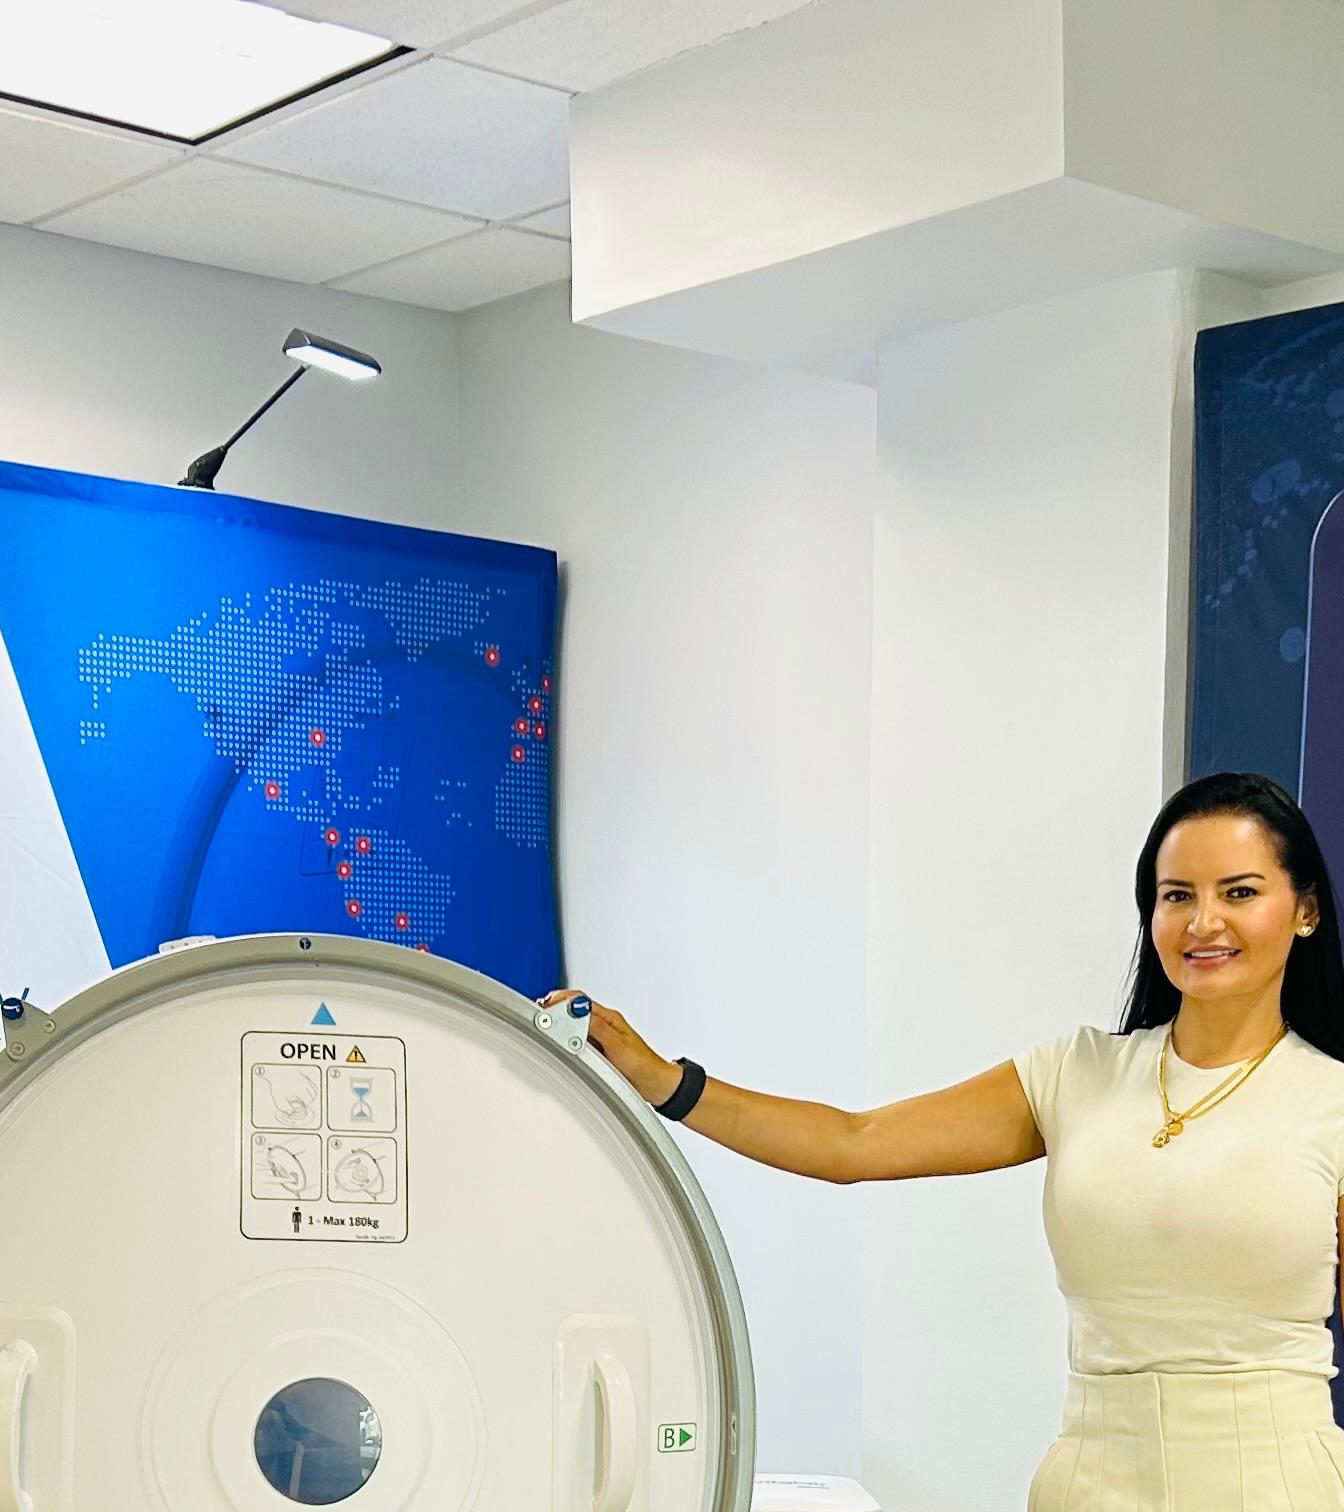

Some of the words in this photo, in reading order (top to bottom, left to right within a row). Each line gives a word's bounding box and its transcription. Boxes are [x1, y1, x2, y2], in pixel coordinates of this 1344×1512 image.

[280, 1042, 337, 1061] OPEN
[323, 1215, 345, 1226] Max
[664, 1428, 675, 1448] B
